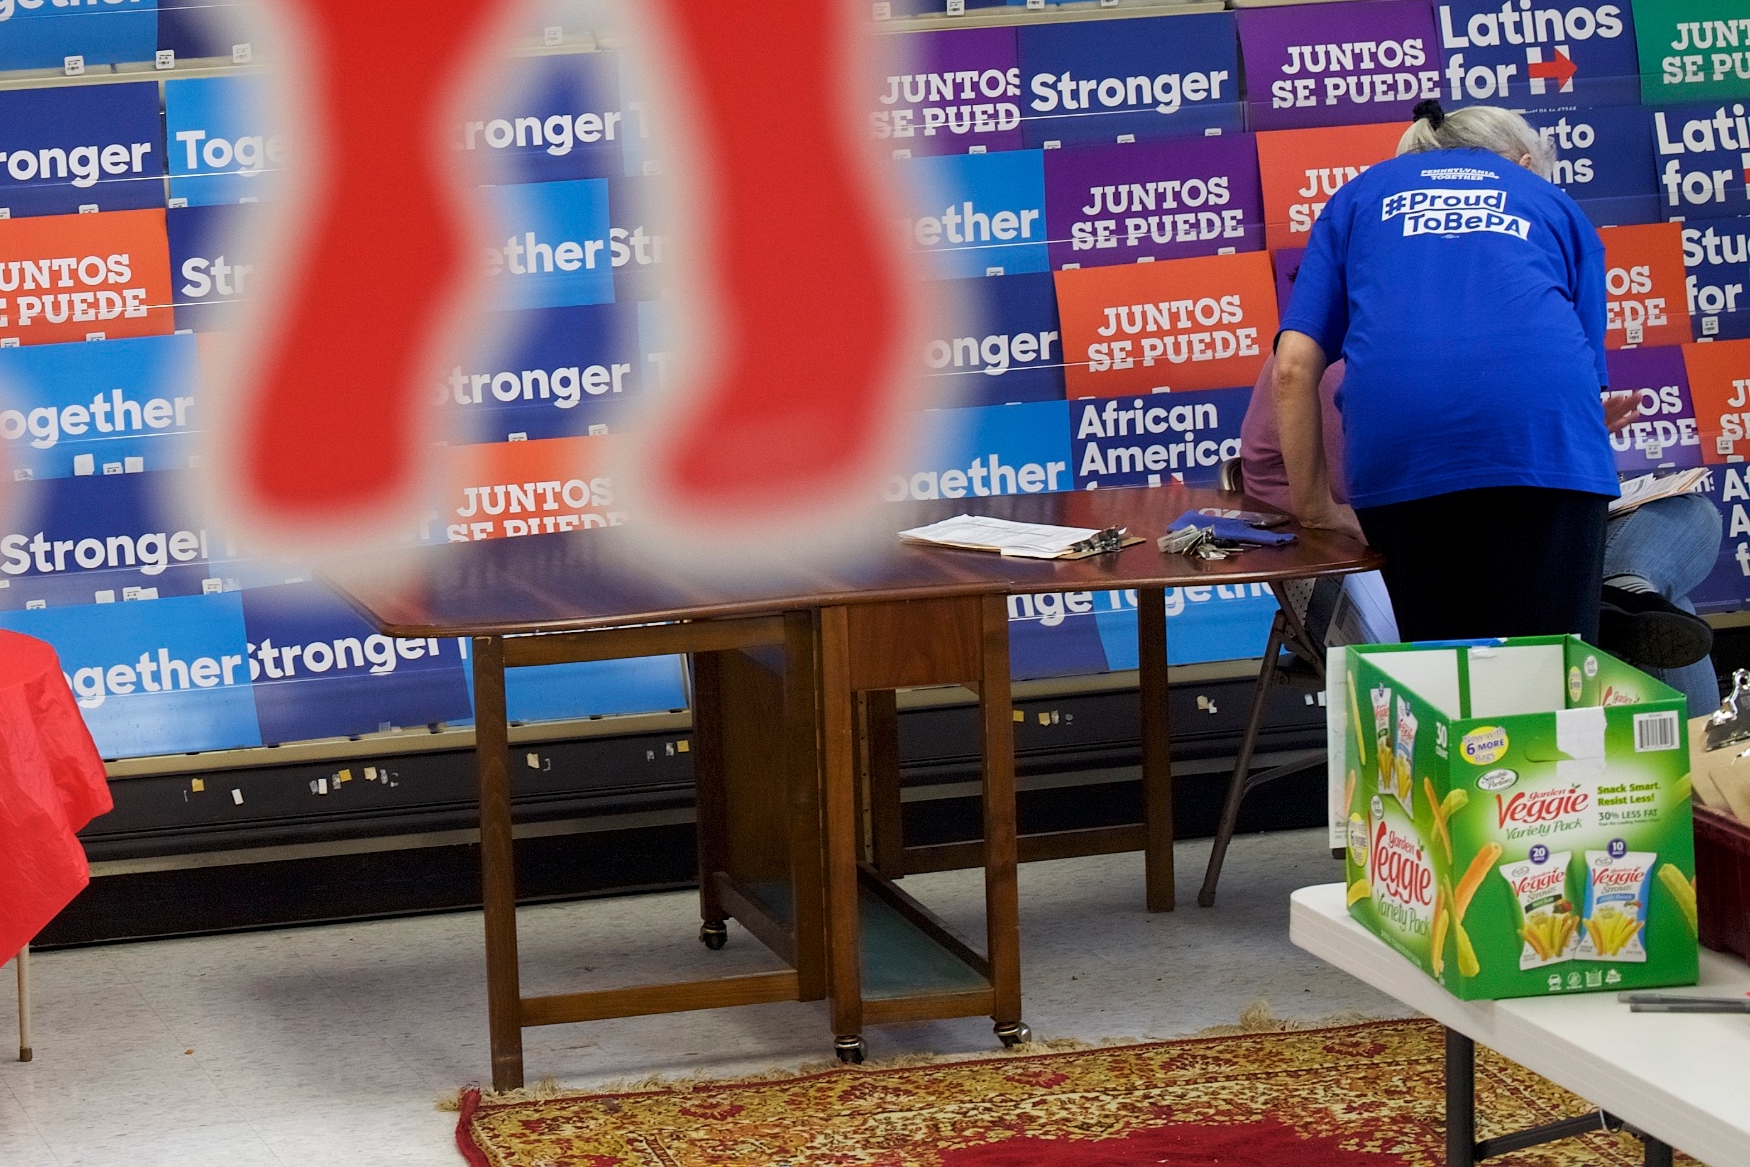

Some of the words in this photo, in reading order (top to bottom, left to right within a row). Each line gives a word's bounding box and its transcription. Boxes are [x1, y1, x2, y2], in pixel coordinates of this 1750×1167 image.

[1282, 39, 1425, 75] JUNTOS
[1662, 55, 1704, 84] SE
[879, 67, 1020, 104] JUNTOS
[1031, 71, 1228, 119] Stronger
[1272, 79, 1316, 108] SE
[1324, 71, 1440, 105] PUEDE
[1445, 54, 1517, 100] for
[1421, 168, 1495, 176] PENNSYLVANIA
[1662, 160, 1733, 206] for
[1082, 177, 1230, 215] JUNTOS
[1385, 192, 1503, 216] #Proud
[1071, 220, 1114, 250] SE
[1125, 209, 1244, 246] PUEDE
[1408, 212, 1521, 235] ToBePA
[17, 288, 147, 325] PUEDE
[1098, 295, 1243, 336] JUNTOS
[1088, 340, 1136, 372] SE
[1138, 327, 1259, 366] PUEDE
[1078, 396, 1217, 441] African
[457, 477, 613, 517] JUNTOS
[1466, 743, 1476, 756] 6
[1477, 739, 1505, 752] MORE
[1597, 785, 1626, 795] Snack
[1629, 782, 1661, 792] Smart.
[1597, 796, 1627, 806] Resist
[1629, 793, 1655, 803] Less!
[1496, 788, 1588, 829] Veggie
[1598, 810, 1619, 822] 30%
[1621, 809, 1641, 819] LESS
[1643, 808, 1658, 818] FAT
[1506, 819, 1551, 840] Variety
[1554, 817, 1583, 831] Pack
[1612, 842, 1623, 851] 10
[1367, 811, 1432, 906] Veggie
[1533, 848, 1546, 857] 20
[1511, 870, 1565, 898] Veggie
[1592, 867, 1645, 888] Veggie
